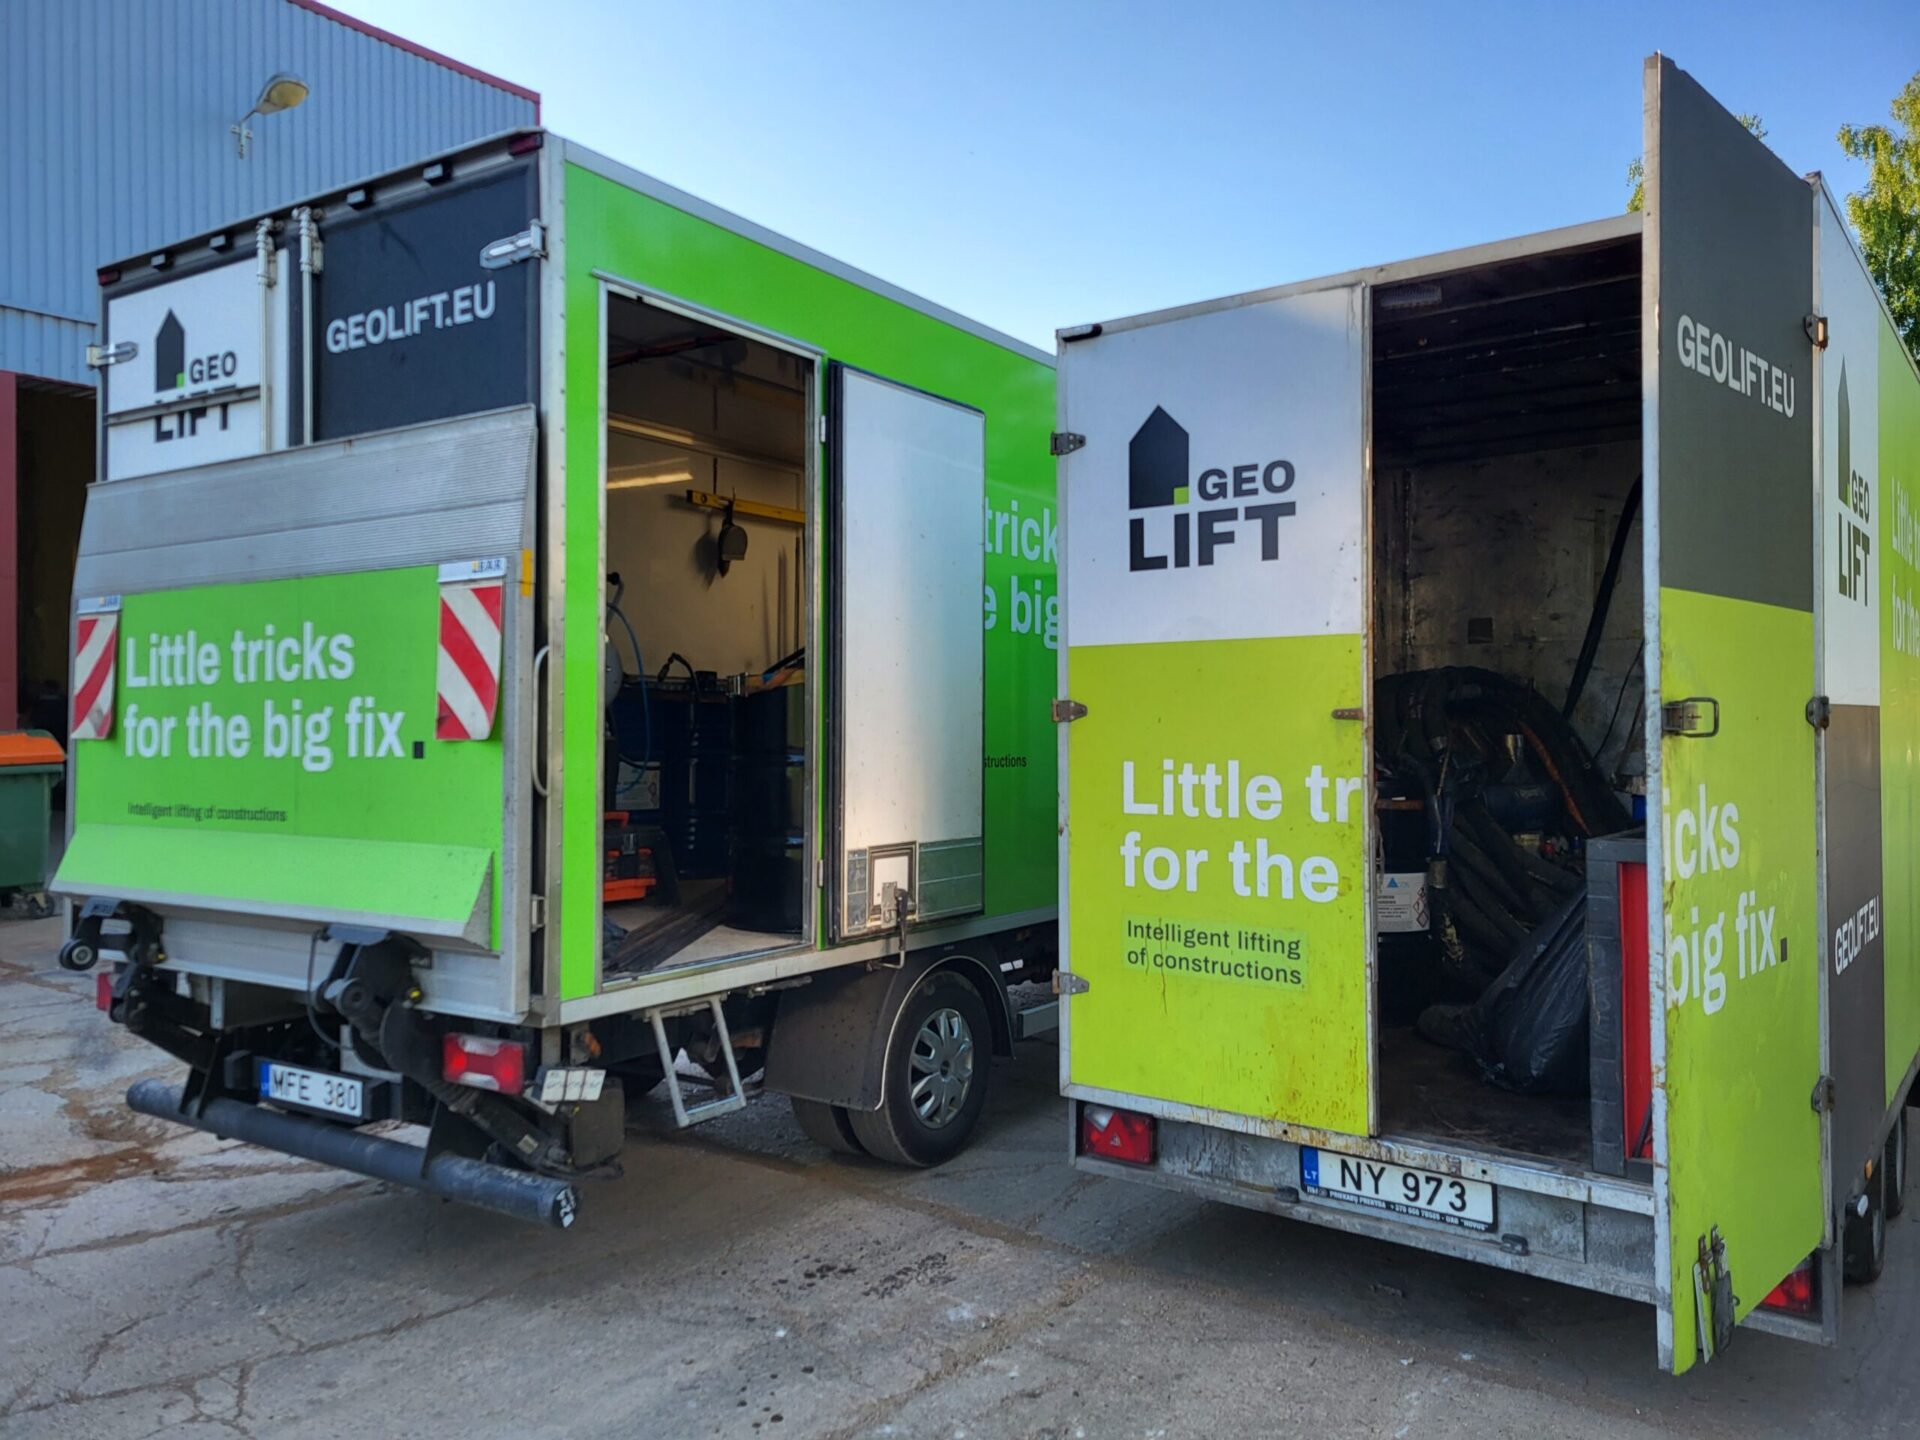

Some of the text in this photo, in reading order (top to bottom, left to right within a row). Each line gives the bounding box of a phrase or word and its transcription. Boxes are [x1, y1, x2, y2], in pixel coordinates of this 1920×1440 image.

[327, 280, 496, 354] GEOLIFT.EU
[190, 351, 237, 384] GEO
[1677, 314, 1795, 418] GEOLIFT.EU
[155, 384, 237, 443] LIFT
[1197, 460, 1296, 501] GEO
[1851, 469, 1870, 525] GEO
[1129, 501, 1297, 572] LIFT
[1892, 476, 1913, 567] Little
[1838, 511, 1870, 607] LIFT
[1892, 573, 1905, 653] for
[126, 621, 355, 688] Little tricks
[124, 703, 178, 758] for
[186, 701, 251, 759] the
[263, 700, 334, 773] big
[128, 802, 288, 823] Intelligent lifting of constructions
[1122, 759, 1362, 823] Little tr
[1663, 784, 1740, 882] icks
[1120, 831, 1339, 903] for the
[1127, 920, 1301, 960] Intelligent lifting
[1127, 948, 1302, 985] of constructions
[1665, 905, 1726, 1015] big
[1834, 895, 1880, 976] GEOLIFT.EU
[272, 1070, 358, 1111] MFE 380
[1304, 1169, 1317, 1181] LT
[1340, 1158, 1467, 1213] NY 973
